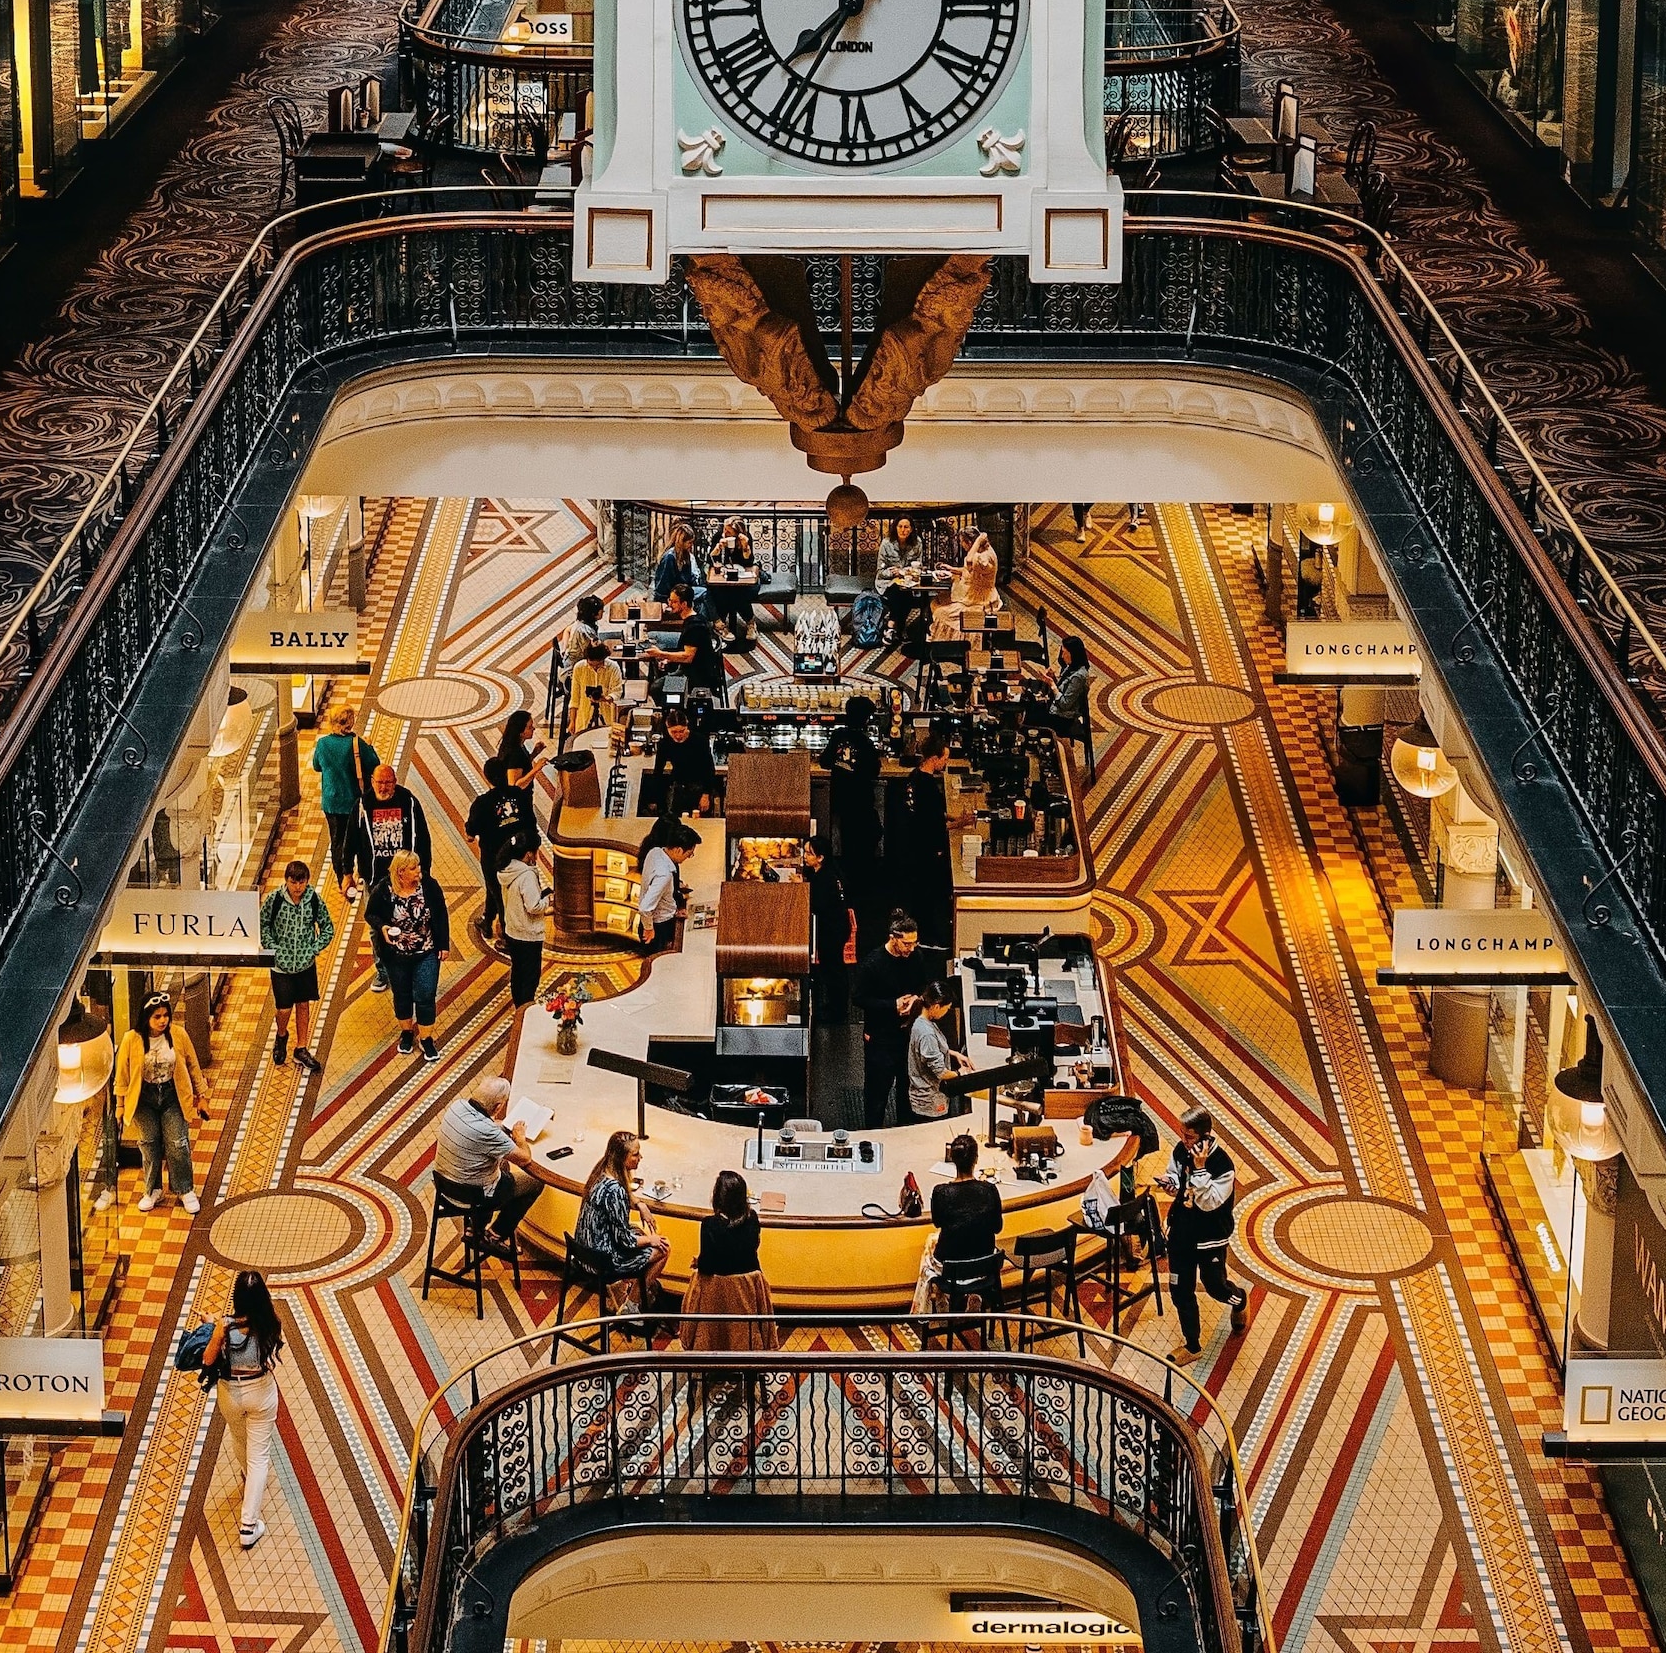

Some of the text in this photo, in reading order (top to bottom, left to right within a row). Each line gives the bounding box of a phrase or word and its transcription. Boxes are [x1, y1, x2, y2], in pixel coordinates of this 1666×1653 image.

[828, 41, 873, 53] LONDON
[270, 632, 349, 647] BALLY
[1305, 644, 1417, 655] LONGCHAMP
[133, 912, 250, 938] FURLA
[1417, 937, 1553, 951] LONGCHAMP
[972, 1620, 1139, 1637] dermalogic
